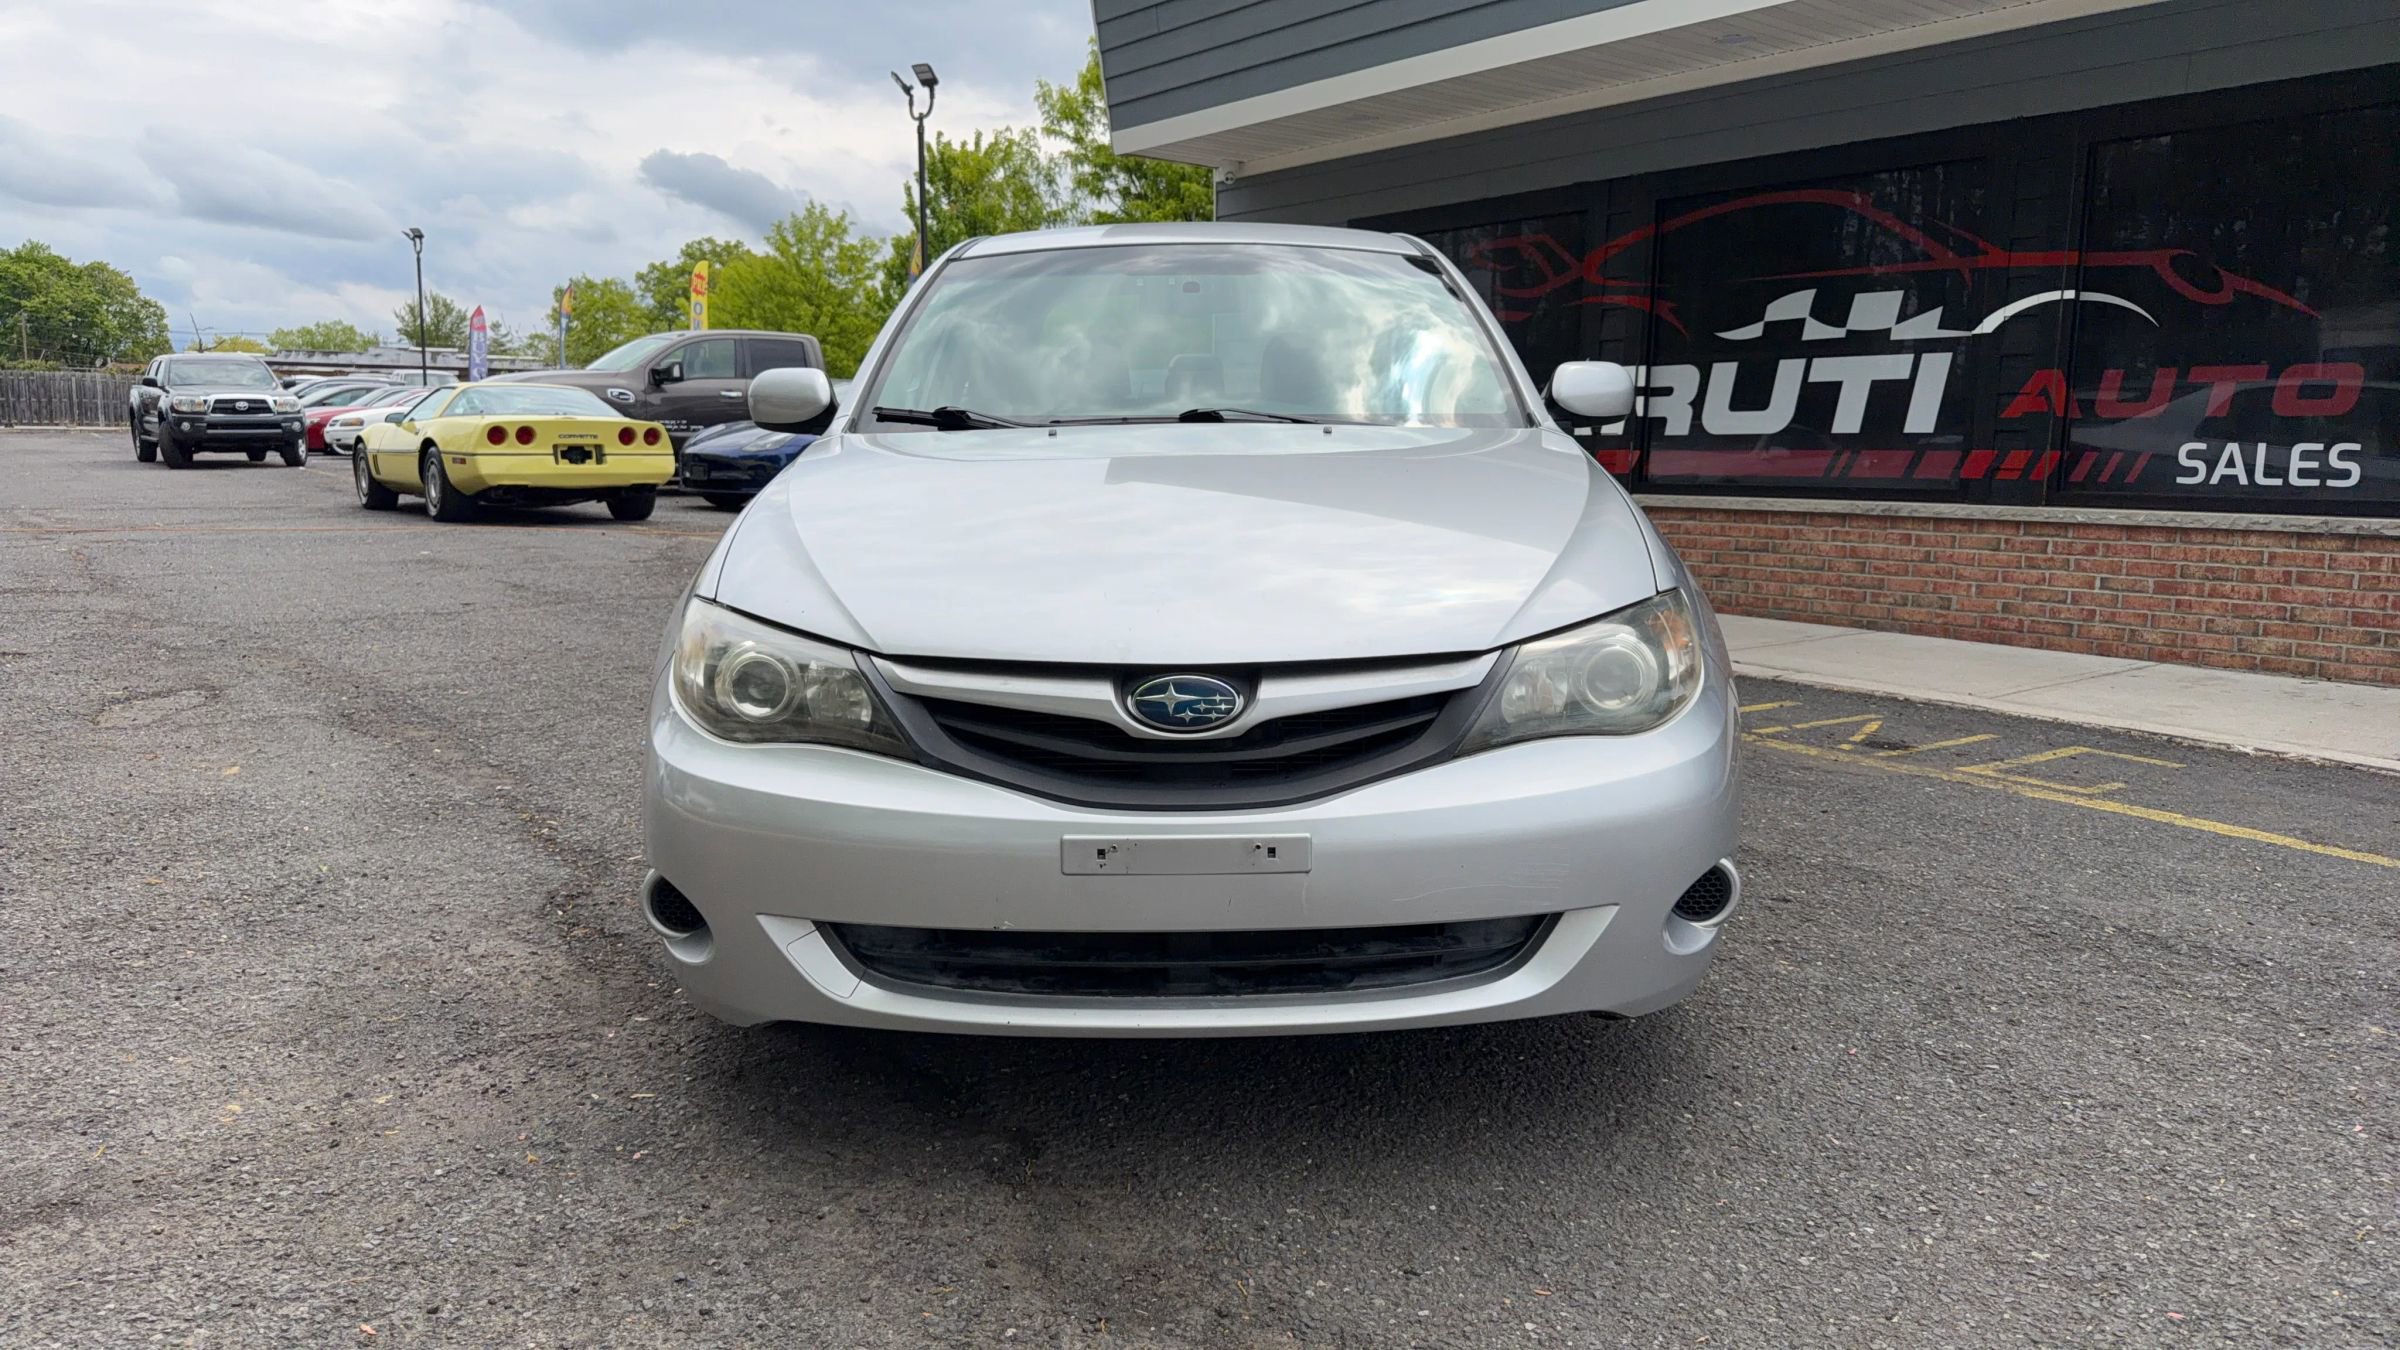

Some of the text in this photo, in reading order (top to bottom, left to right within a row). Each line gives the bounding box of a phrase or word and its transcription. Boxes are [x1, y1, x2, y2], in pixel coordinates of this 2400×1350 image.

[1574, 352, 2365, 436] RUTI AUTO
[2176, 442, 2362, 487] SALES
